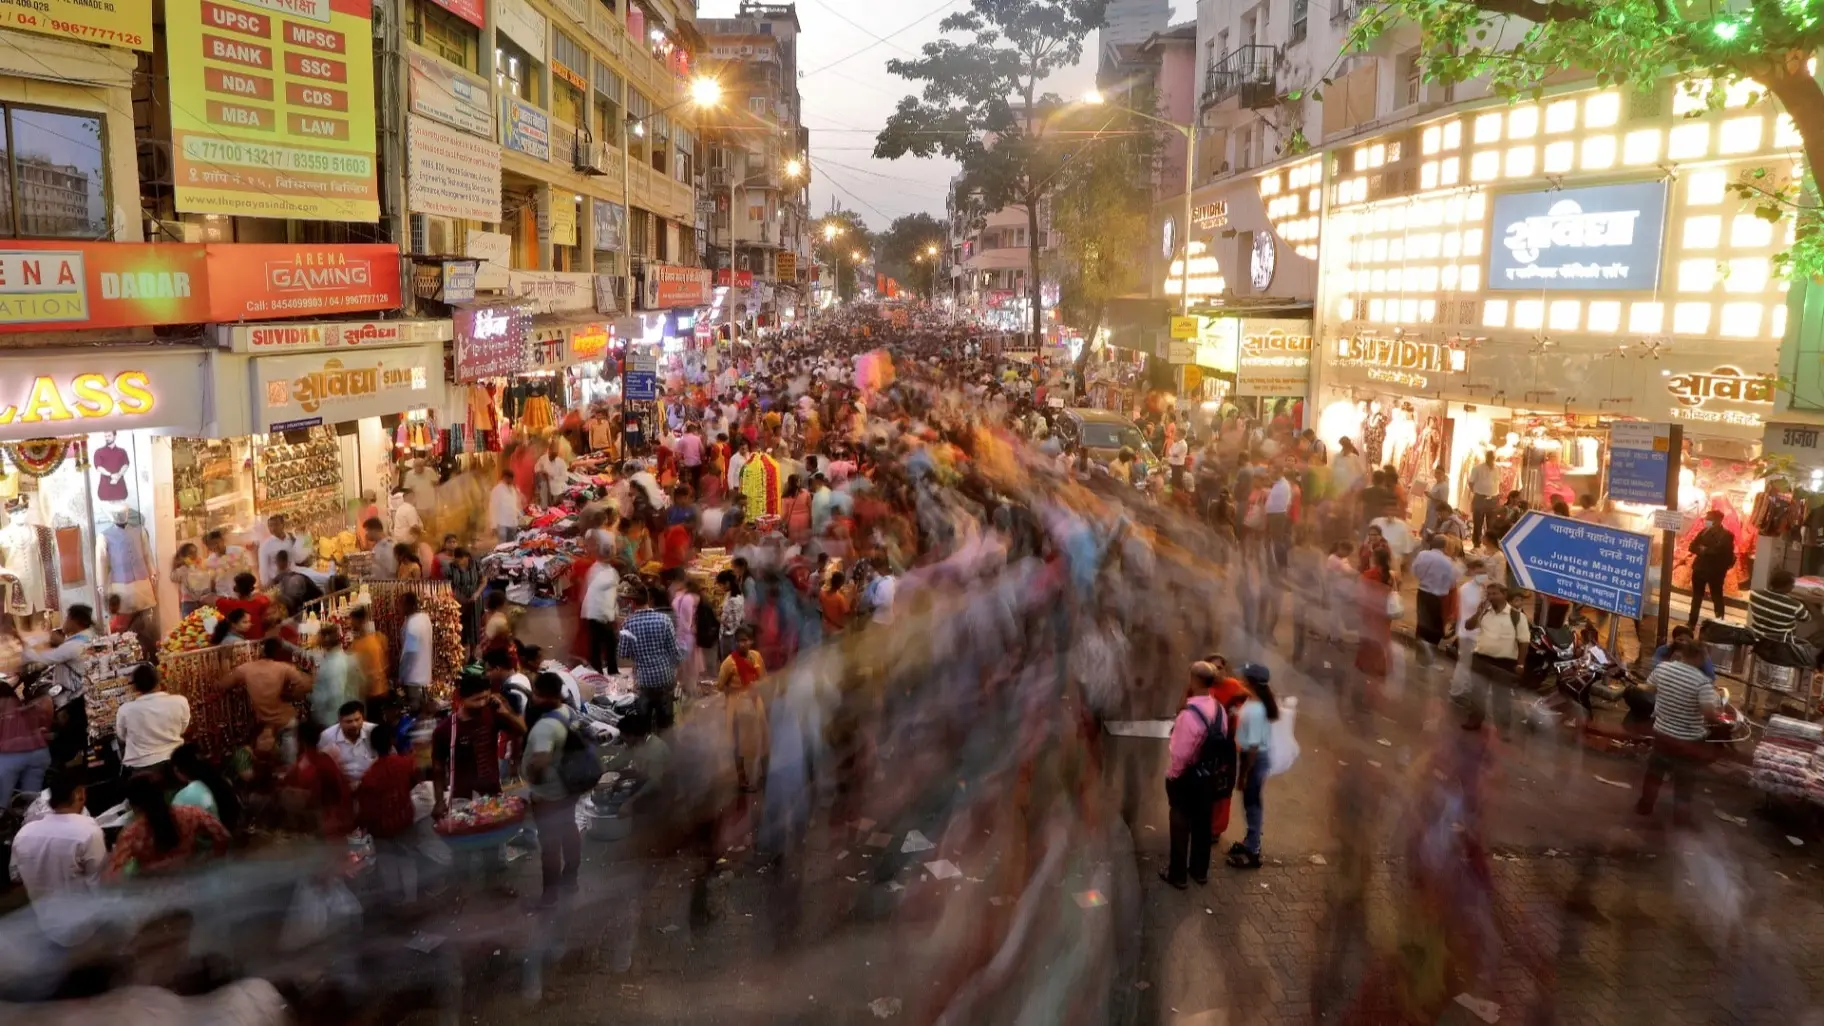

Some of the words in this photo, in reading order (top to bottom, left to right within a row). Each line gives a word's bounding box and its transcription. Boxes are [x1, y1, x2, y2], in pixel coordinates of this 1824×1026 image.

[17, 13, 37, 25] 04
[213, 8, 260, 32] UPSC
[293, 26, 336, 49] MPSC
[213, 40, 262, 64] BANK
[301, 59, 332, 77] SSC
[222, 75, 257, 94] NDA
[302, 89, 333, 106] CDS
[222, 107, 260, 126] MBA
[301, 119, 335, 136] LAW
[202, 142, 242, 161] 77100
[248, 147, 283, 167] 13217
[293, 153, 329, 170] 83559
[332, 157, 367, 173] 51603
[185, 195, 319, 212] www.theprayasindia.com
[1504, 199, 1641, 264] सुविधा
[294, 253, 346, 266] ARENA
[100, 271, 191, 299] DADAR
[271, 267, 367, 290] GAMING
[721, 276, 752, 287] TIAN
[246, 300, 269, 312] Call:
[252, 327, 321, 345] SUVIDHA
[344, 324, 397, 345] सुविधा
[1241, 328, 1314, 357] सुविधा
[293, 358, 378, 413] सुविधा
[1667, 365, 1777, 408] सुविध
[0, 370, 155, 424] ASS
[1586, 531, 1616, 546] महादेव
[1551, 551, 1589, 567] Justice
[1592, 561, 1642, 579] Mahadeo
[1599, 548, 1623, 561] रानडे
[1626, 554, 1644, 565] मार्ग
[1530, 556, 1566, 571] Govind
[1568, 565, 1608, 581] Ranade
[1611, 576, 1641, 590] Road
